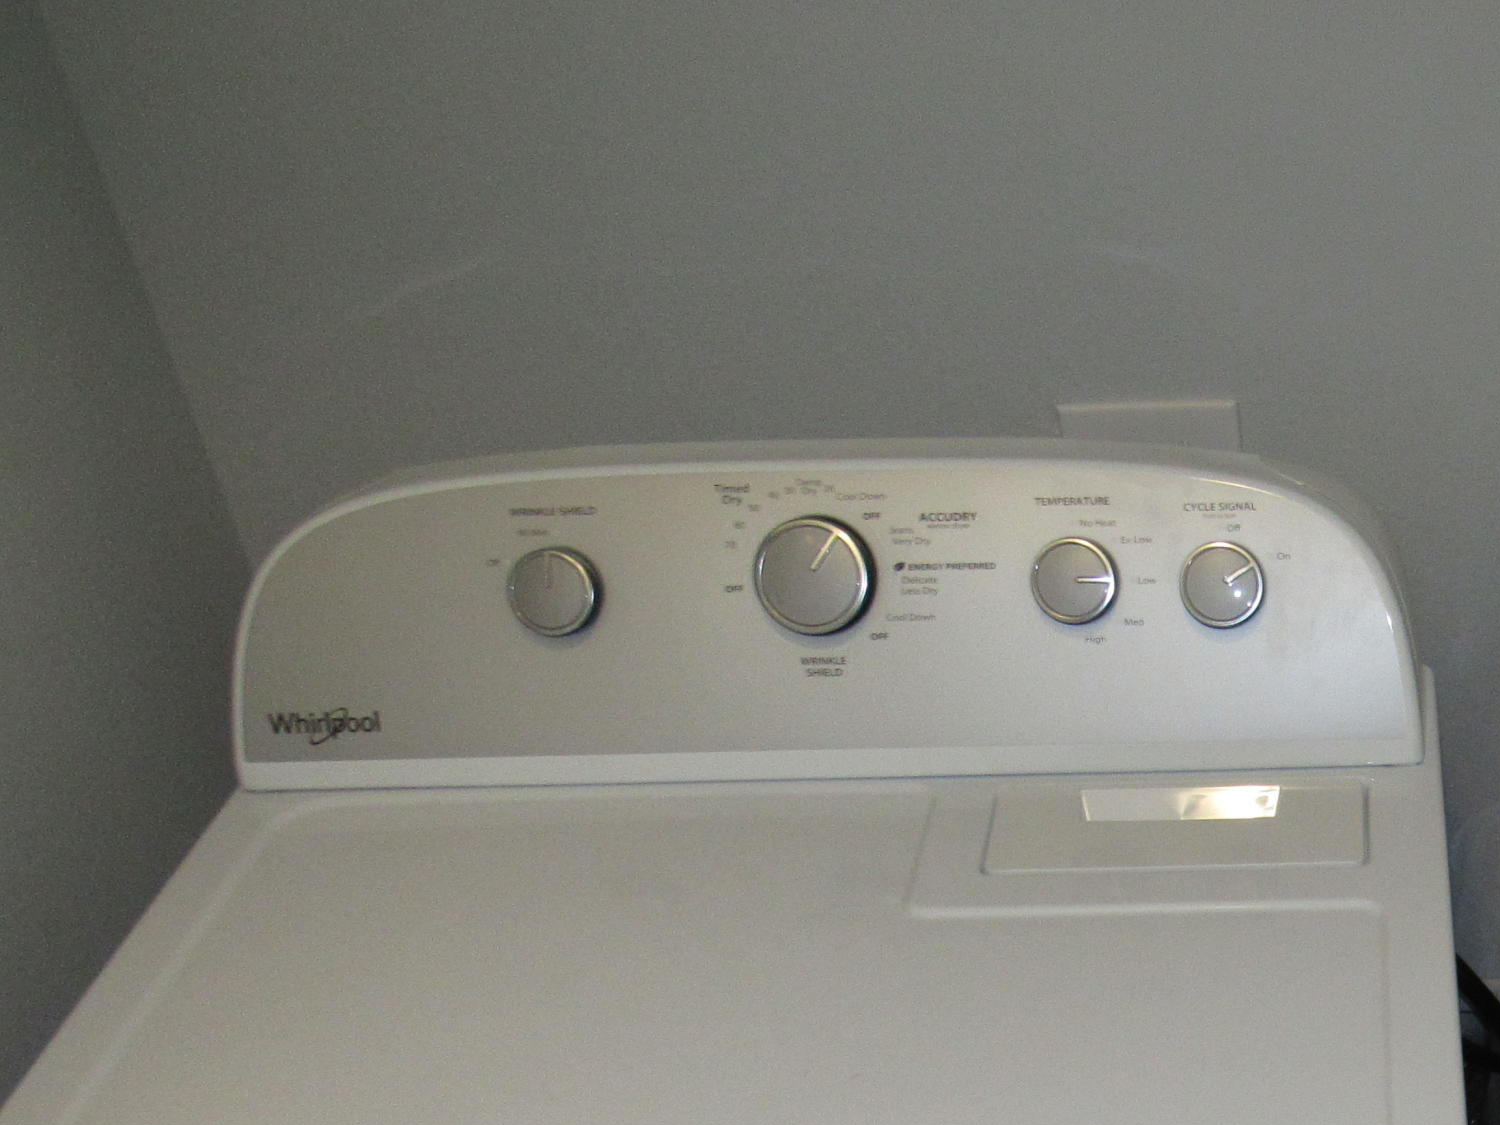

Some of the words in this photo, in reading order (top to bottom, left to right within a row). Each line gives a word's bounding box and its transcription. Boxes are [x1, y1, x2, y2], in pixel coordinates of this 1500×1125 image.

[722, 494, 742, 506] Dry
[1034, 496, 1111, 506] TEMPERATURE
[1184, 502, 1216, 512] CYCLE
[1217, 502, 1257, 511] SIGNAL
[919, 512, 977, 523] ACCUDRY
[1133, 536, 1153, 544] Low
[1277, 552, 1292, 561] On
[910, 613, 936, 621] Down
[801, 656, 847, 666] WRINKLE
[806, 668, 844, 677] SHIELD
[268, 707, 382, 744] Whirlpool
